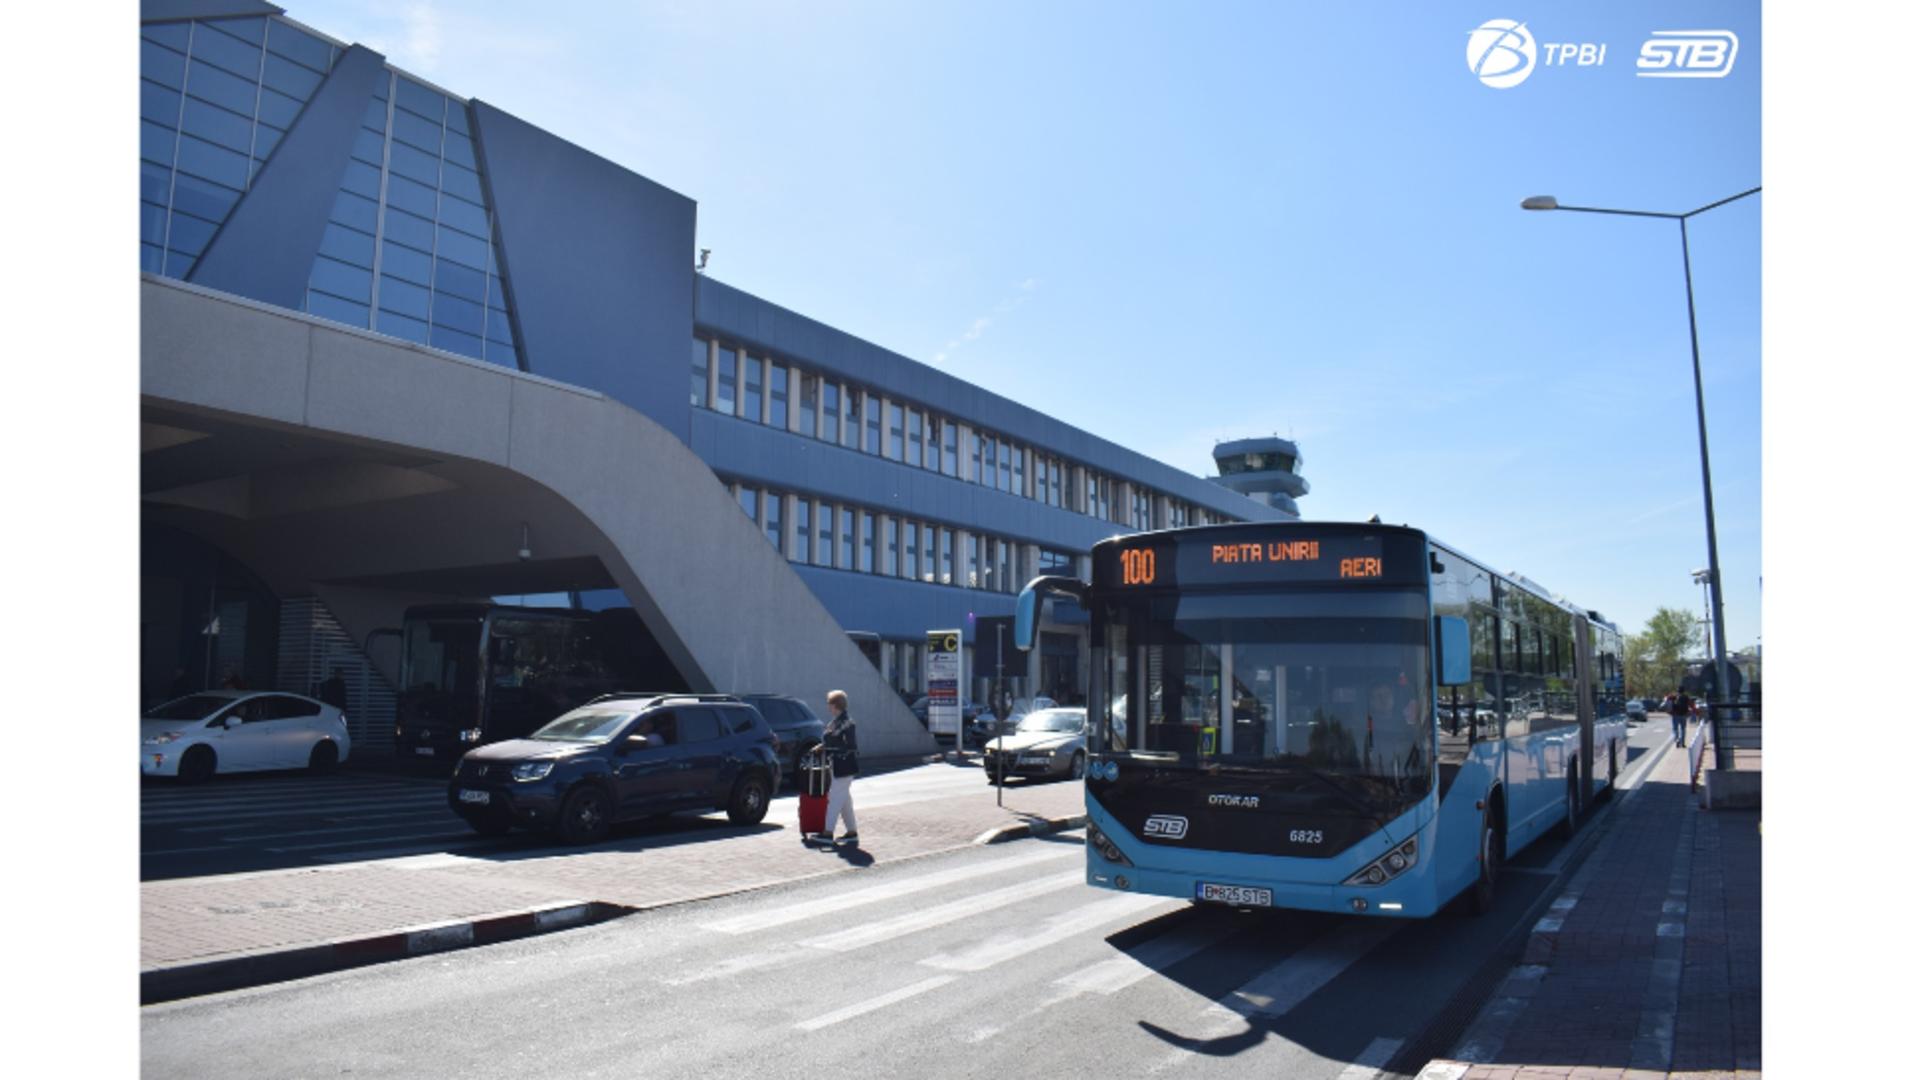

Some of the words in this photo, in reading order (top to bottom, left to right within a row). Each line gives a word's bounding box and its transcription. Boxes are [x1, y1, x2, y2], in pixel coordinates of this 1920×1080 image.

[1212, 545, 1262, 563] PIATA
[1268, 541, 1319, 561] UNIRII
[1120, 549, 1155, 584] 100
[1340, 558, 1381, 577] AERI
[944, 634, 957, 651] C
[1208, 794, 1259, 808] OTOKAR
[1144, 818, 1185, 835] STB
[1289, 830, 1323, 844] 6825
